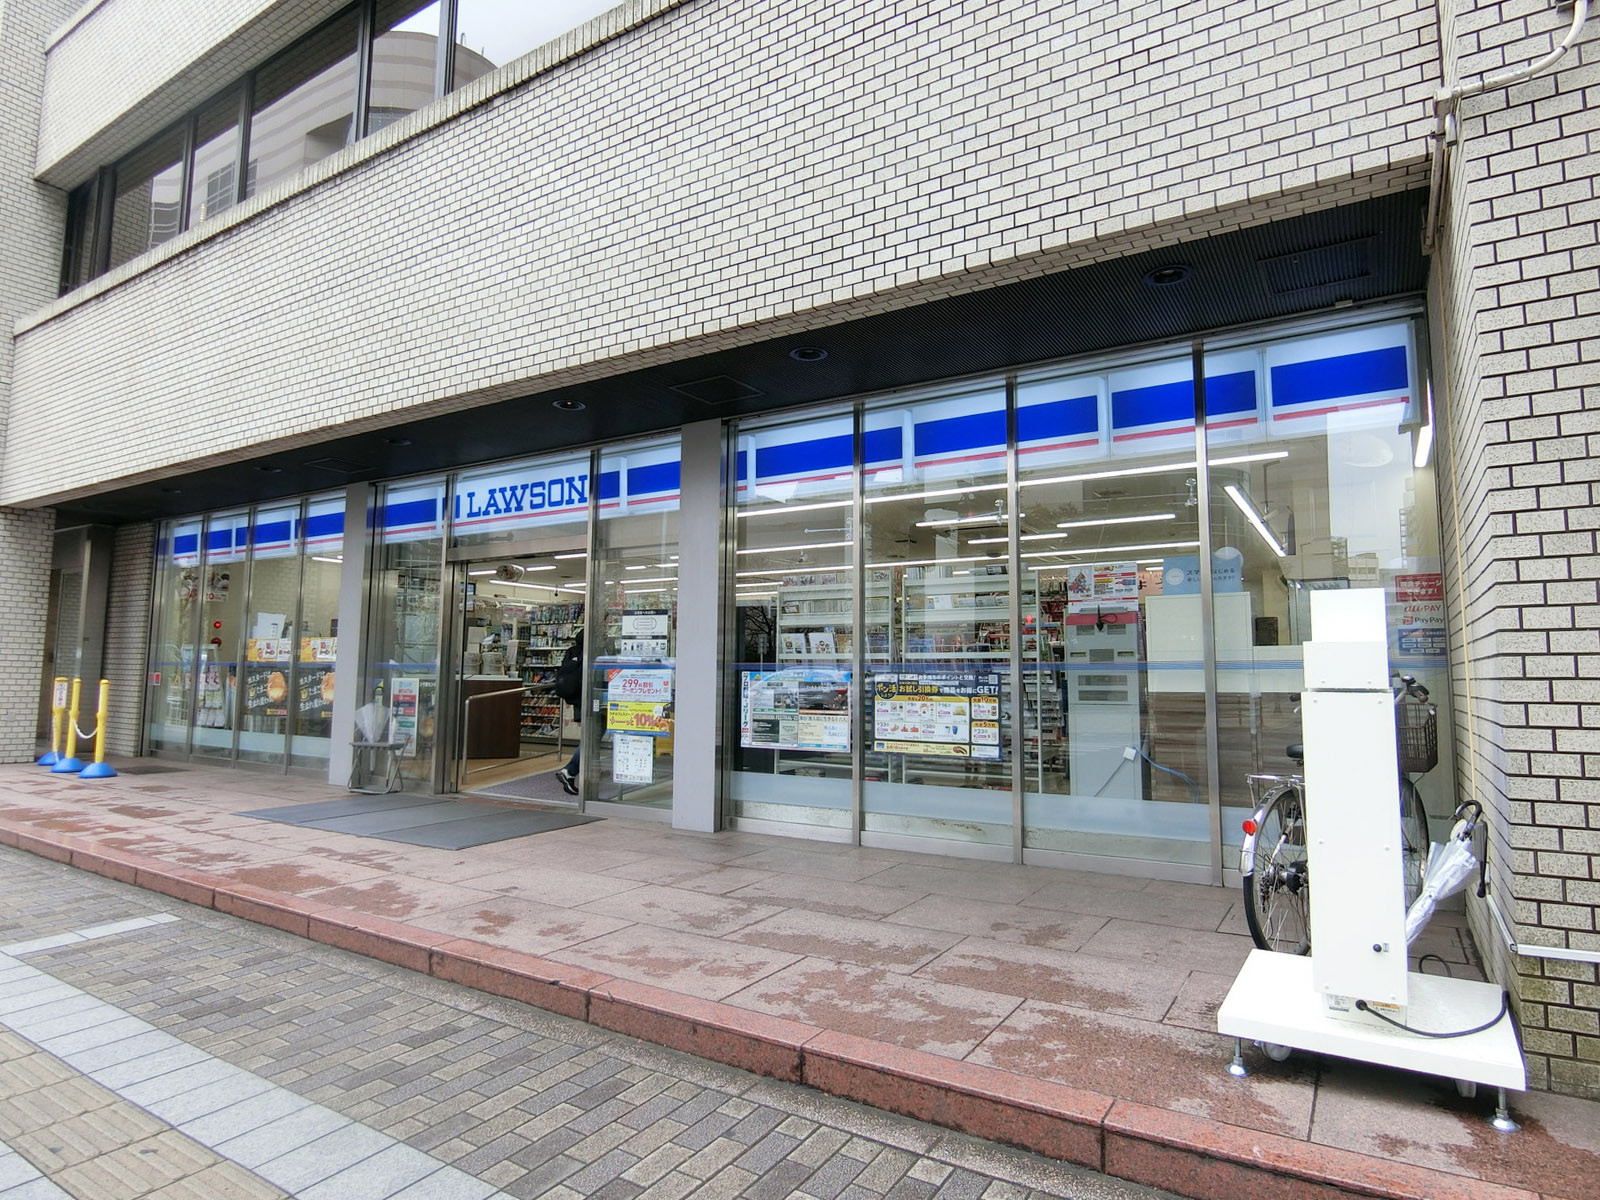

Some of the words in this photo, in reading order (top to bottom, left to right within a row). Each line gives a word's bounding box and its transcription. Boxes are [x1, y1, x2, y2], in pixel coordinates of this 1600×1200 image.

[467, 474, 588, 518] LAWSON
[1424, 604, 1441, 612] PAY
[1414, 616, 1445, 624] PayPay
